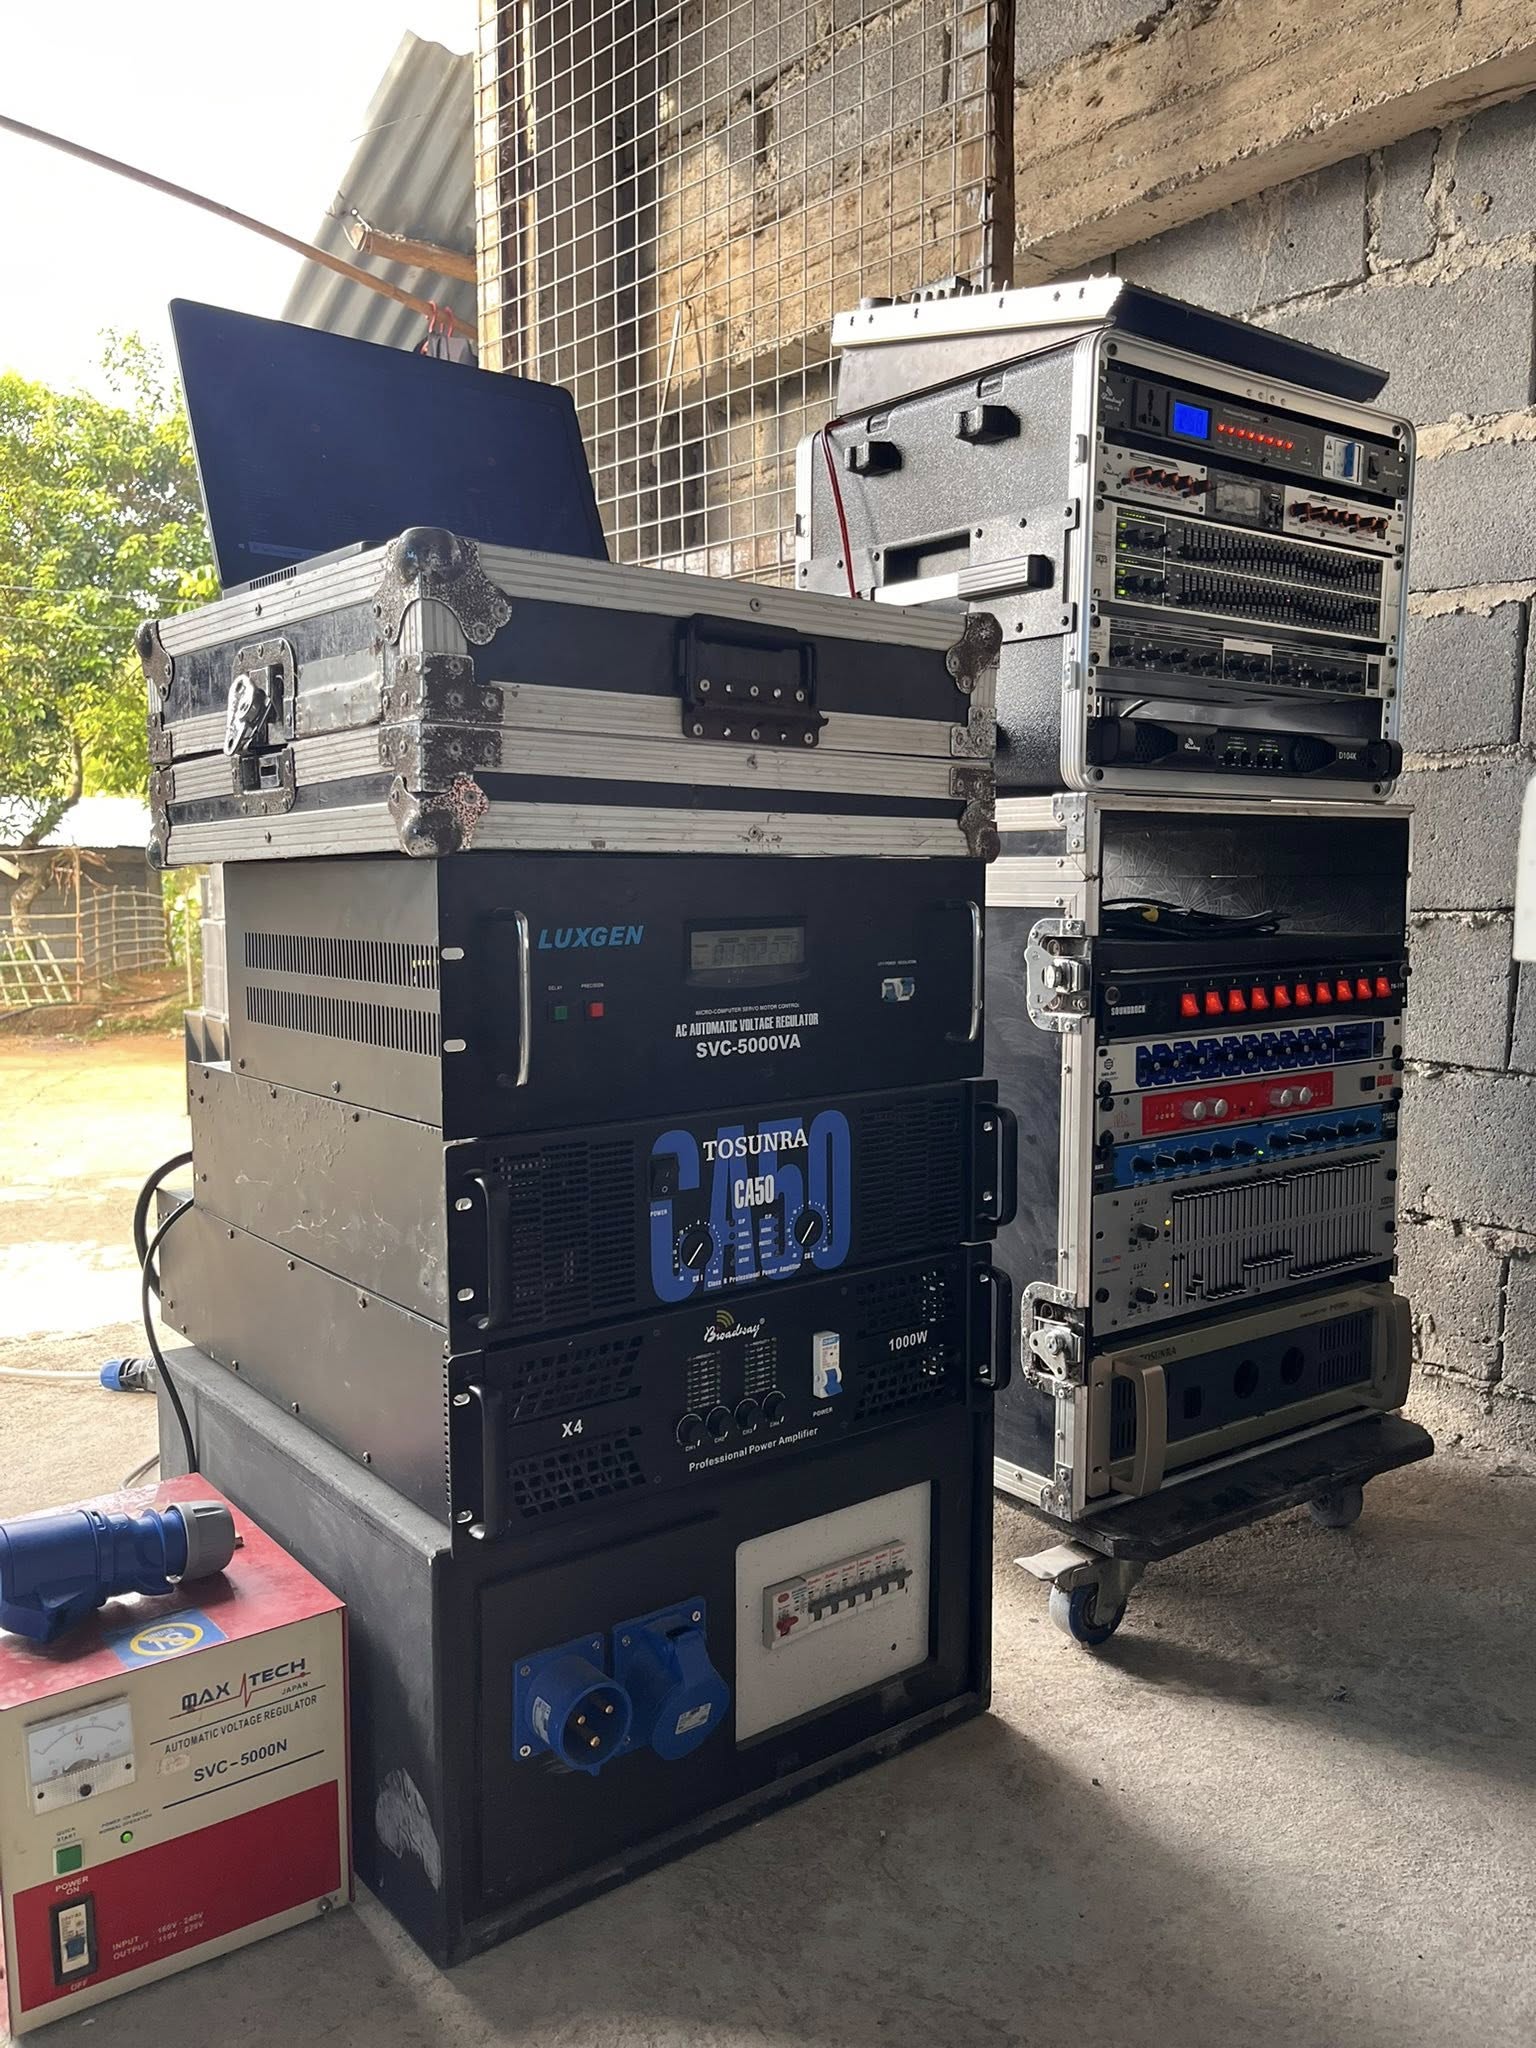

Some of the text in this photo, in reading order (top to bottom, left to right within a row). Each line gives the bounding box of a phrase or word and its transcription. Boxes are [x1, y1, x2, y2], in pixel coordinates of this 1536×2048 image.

[537, 925, 645, 950] LUXGEN
[695, 1002, 800, 1016] MICRO-COMPUTER SERVO MOTOR CONTROL
[675, 1012, 820, 1038] AC AUTOMATIC VOLTAGE REGULATOR
[695, 1033, 801, 1059] SVC-5000VA
[702, 1127, 809, 1162] TOSUNRA
[734, 1174, 775, 1210] CA50
[650, 1208, 668, 1218] POWER
[728, 1270, 761, 1284] Professional
[761, 1267, 778, 1276] Power
[779, 1262, 802, 1273] Amplifier
[888, 1329, 929, 1352] 1000W
[812, 1406, 833, 1418] POWER
[561, 1419, 584, 1438] X4
[688, 1427, 819, 1472] Professional Power Amplifier
[181, 1657, 306, 1713] MAX TECH
[281, 1680, 310, 1696] JAPAN
[164, 1693, 318, 1755] AUTOMATIC VOLTAGE REGULATOR
[193, 1738, 288, 1783] SVC-5000N
[56, 1826, 76, 1837] QUICK
[56, 1832, 77, 1843] START
[55, 1875, 89, 1892] POWER
[65, 1884, 81, 1896] ON
[112, 1935, 140, 1952] INPUT
[112, 1940, 150, 1961] OUTPUT
